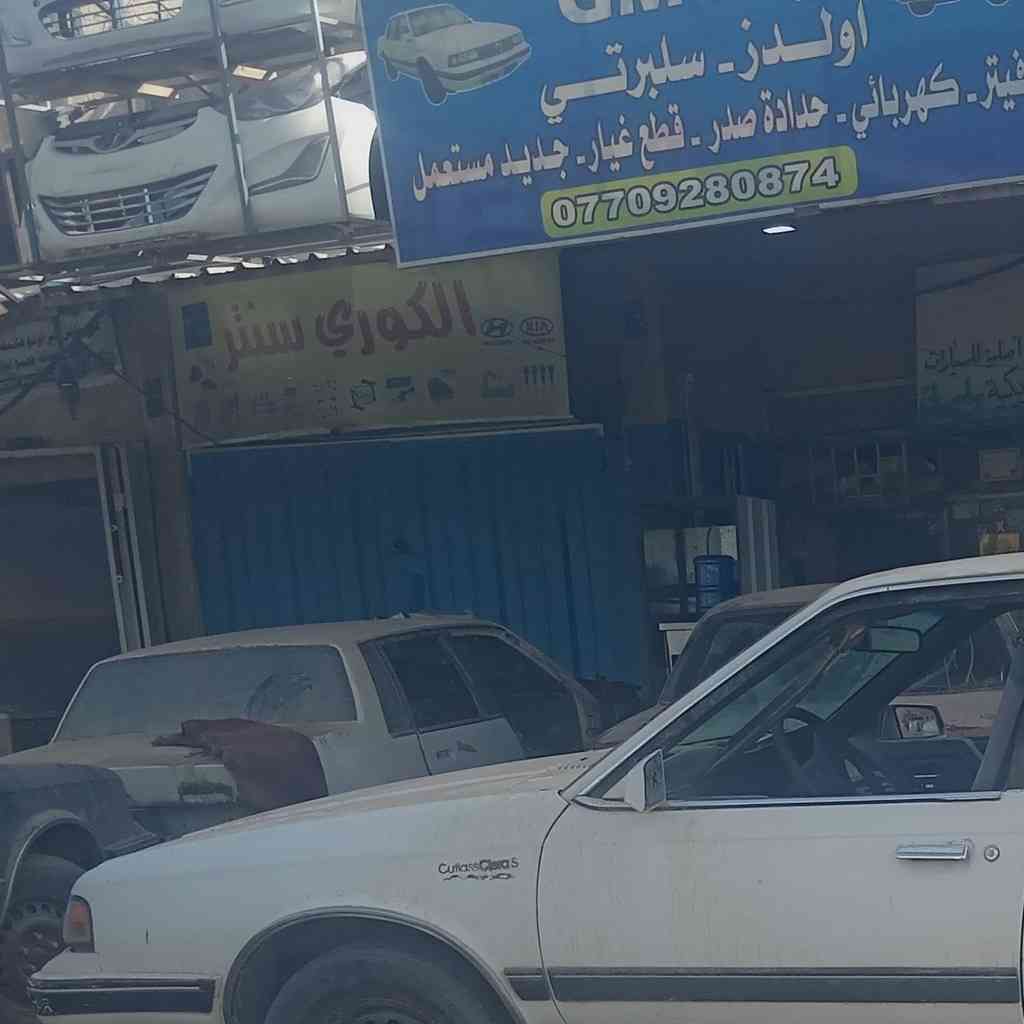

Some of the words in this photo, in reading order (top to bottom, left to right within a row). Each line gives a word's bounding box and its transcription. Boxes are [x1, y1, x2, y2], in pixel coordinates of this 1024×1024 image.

[708, 103, 758, 153] صدر
[760, 87, 829, 135] حدادة
[852, 62, 960, 140] كهربائي
[500, 135, 570, 187] جديد
[588, 114, 634, 173] غيار
[638, 104, 687, 171] قطع
[412, 143, 496, 202] مستعمل
[550, 156, 842, 228] 07709280874
[315, 280, 478, 359] الكوري
